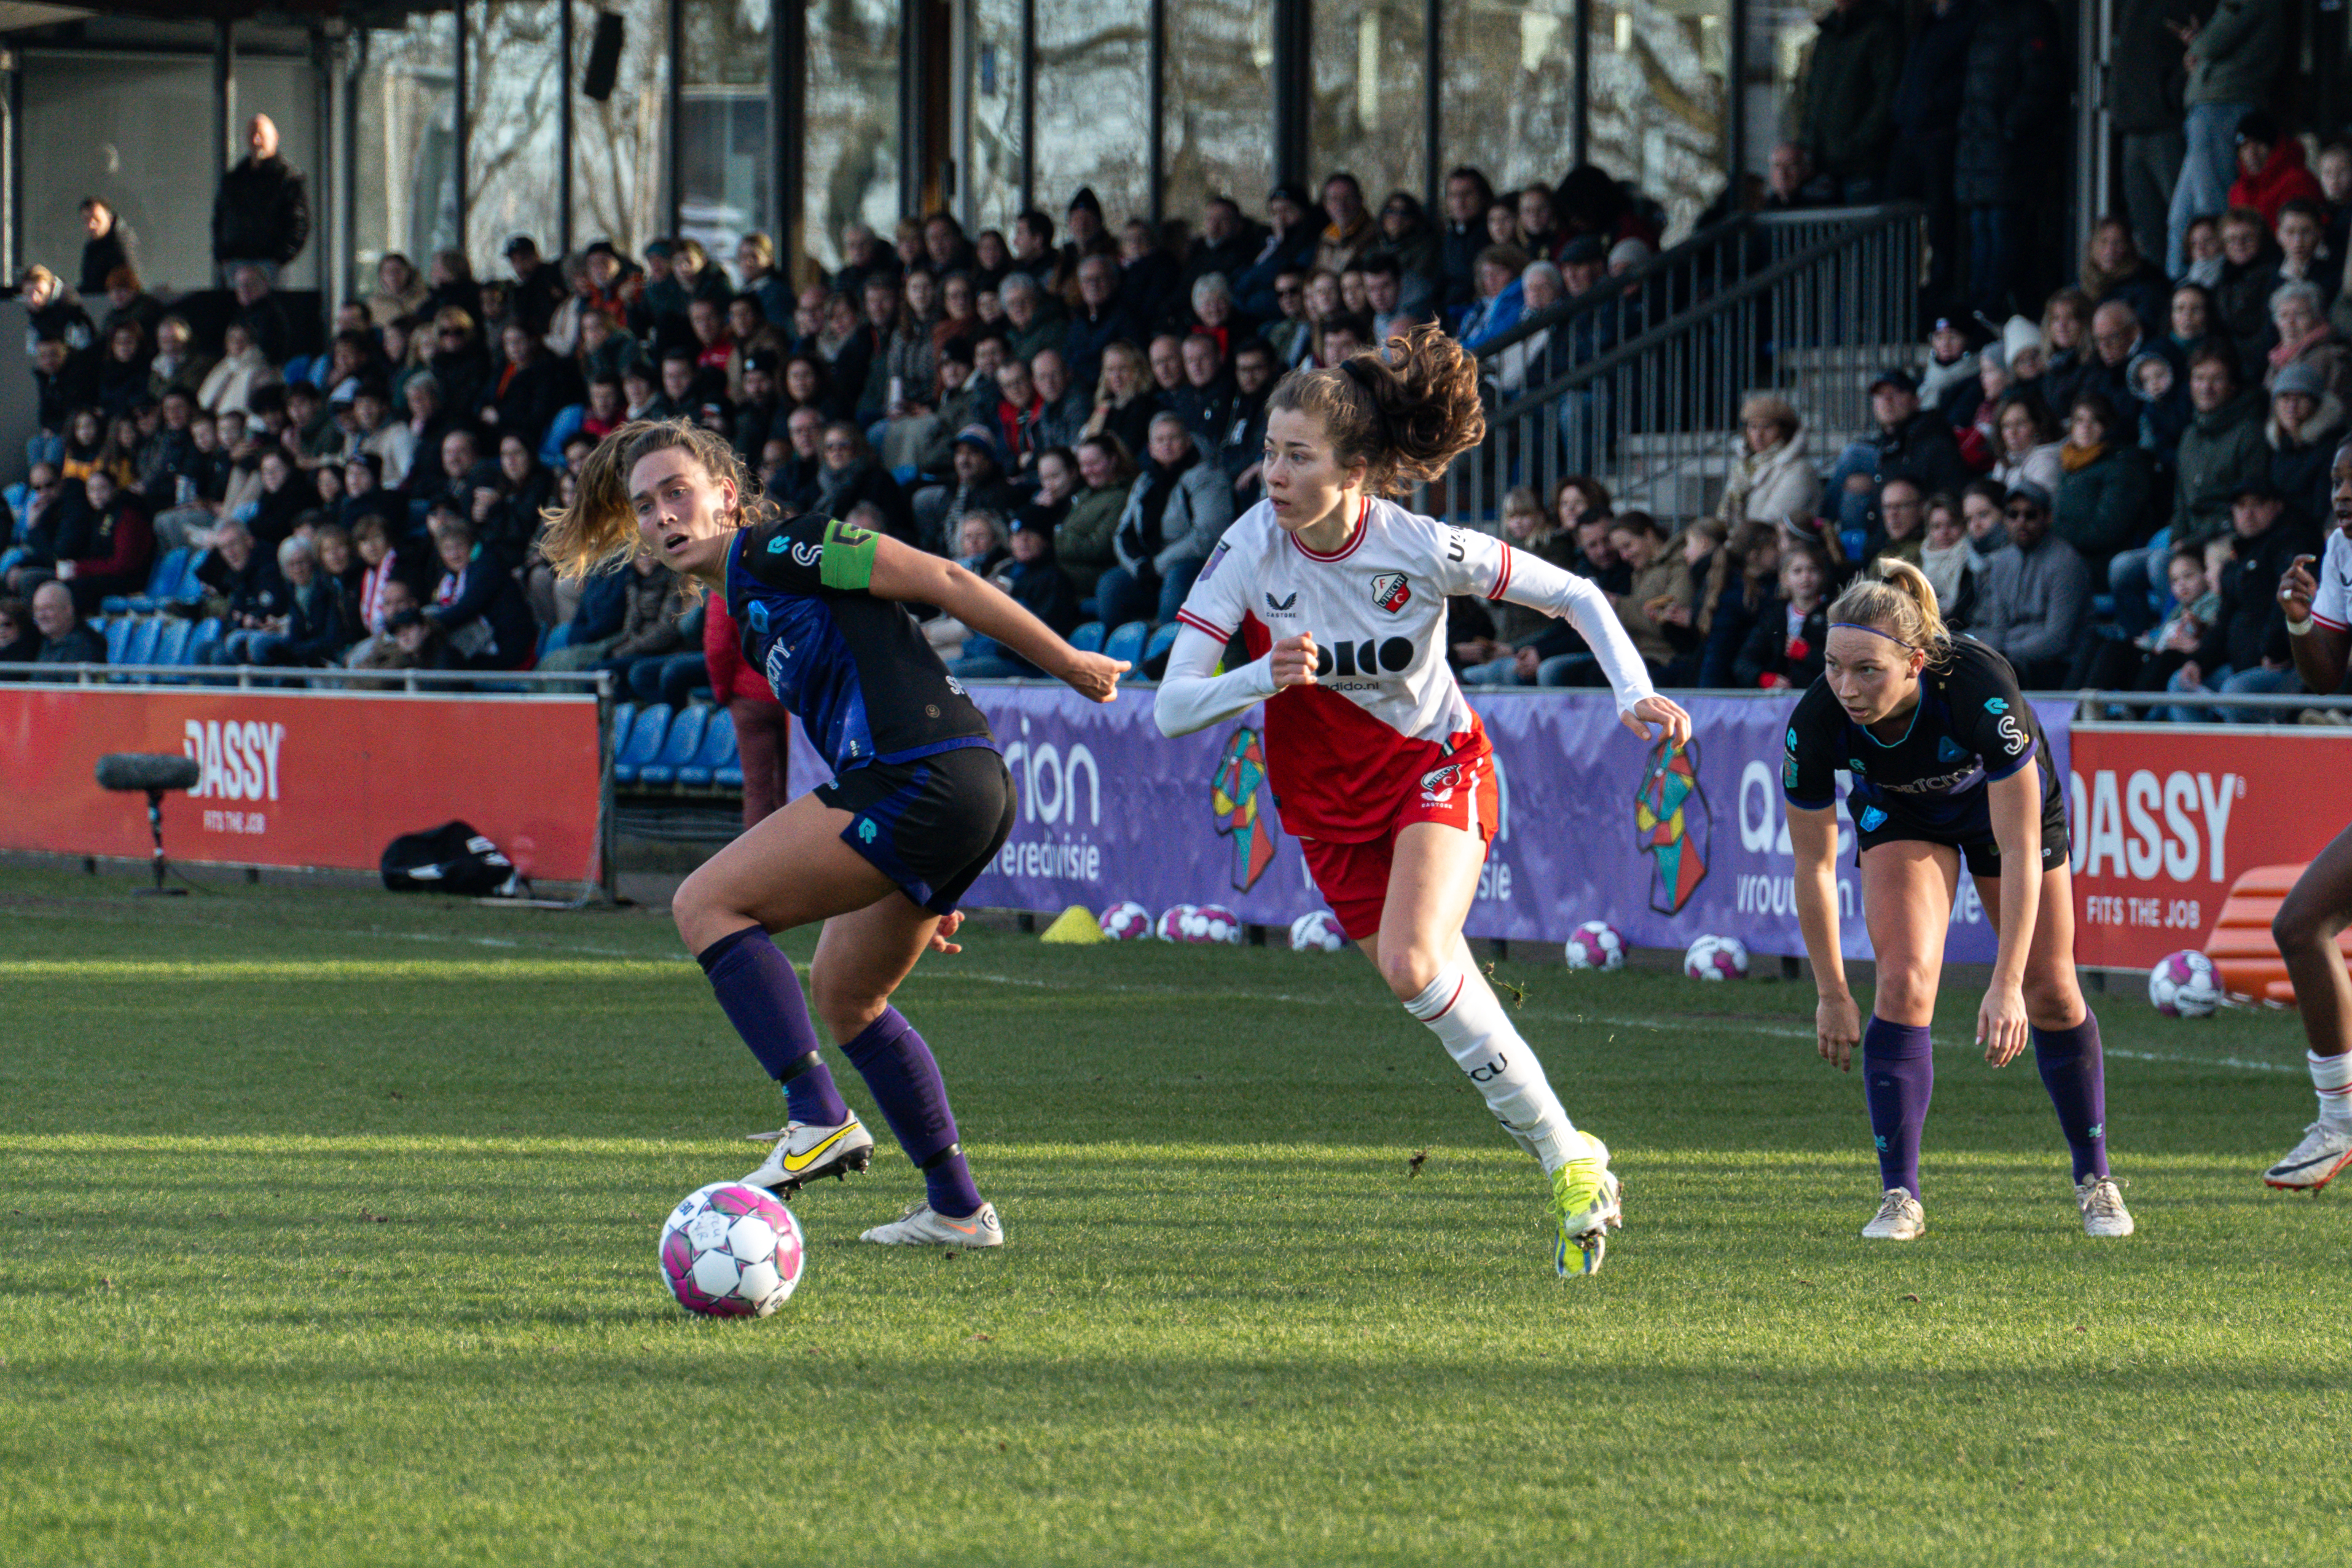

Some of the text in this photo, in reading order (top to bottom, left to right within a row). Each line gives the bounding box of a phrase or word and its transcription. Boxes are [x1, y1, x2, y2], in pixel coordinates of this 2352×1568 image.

[1378, 575, 1405, 607] UTRECHT
[1379, 579, 1386, 589] F
[1394, 594, 1404, 603] C
[1317, 681, 1379, 692] odido.nl
[1003, 716, 1100, 826] rion
[1737, 873, 1854, 920] vroun
[2087, 895, 2200, 930] FITS THE JOB
[1465, 1052, 1508, 1082] CU
